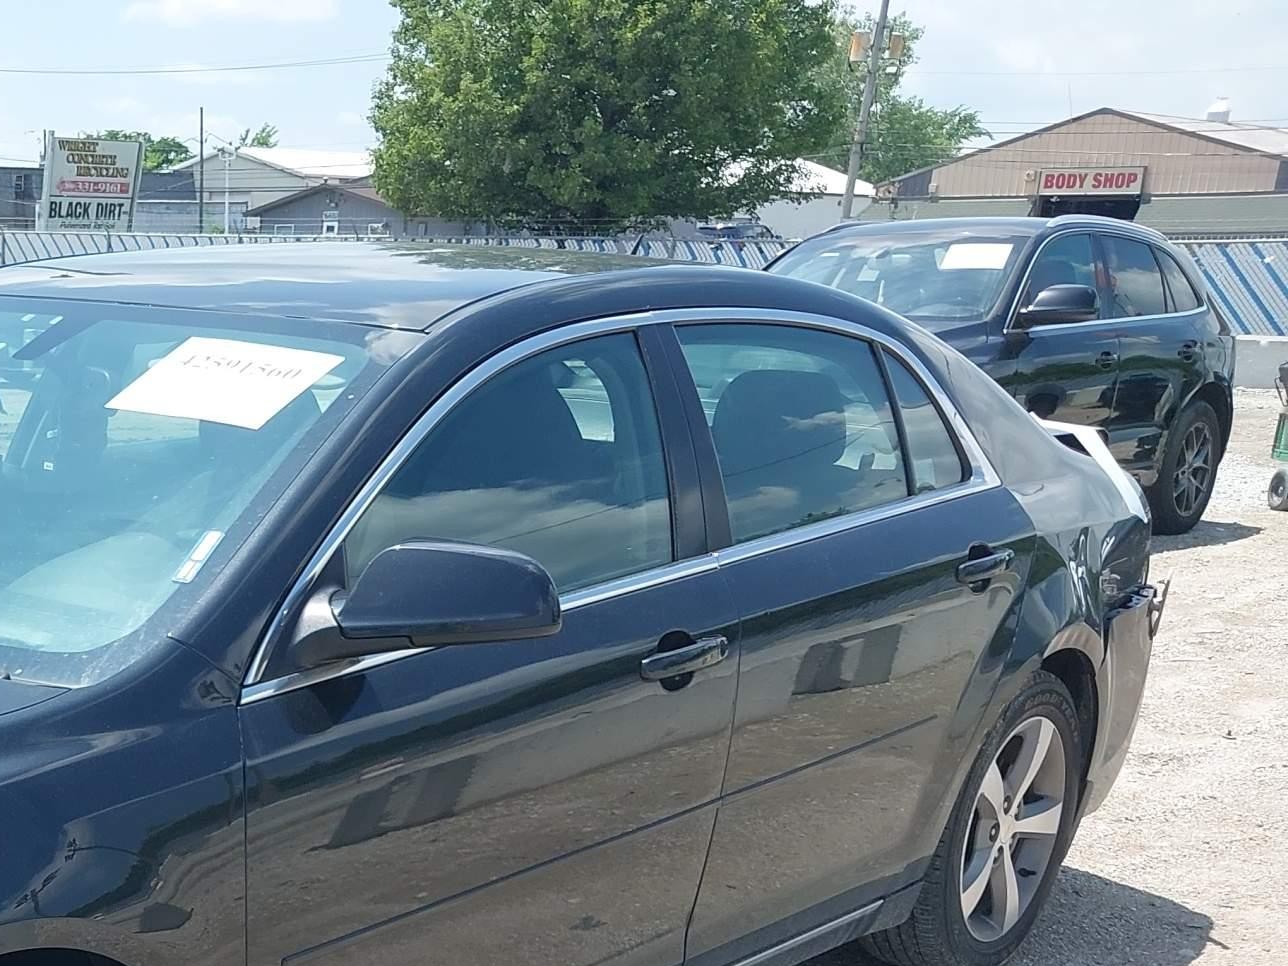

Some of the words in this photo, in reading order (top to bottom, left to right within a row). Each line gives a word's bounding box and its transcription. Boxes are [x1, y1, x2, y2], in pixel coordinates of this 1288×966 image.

[66, 153, 117, 165] CONCRETE
[76, 165, 129, 178] RECYCLING
[1043, 172, 1088, 189] BODY
[1092, 172, 1138, 189] SHOP
[48, 200, 92, 219] BLACK
